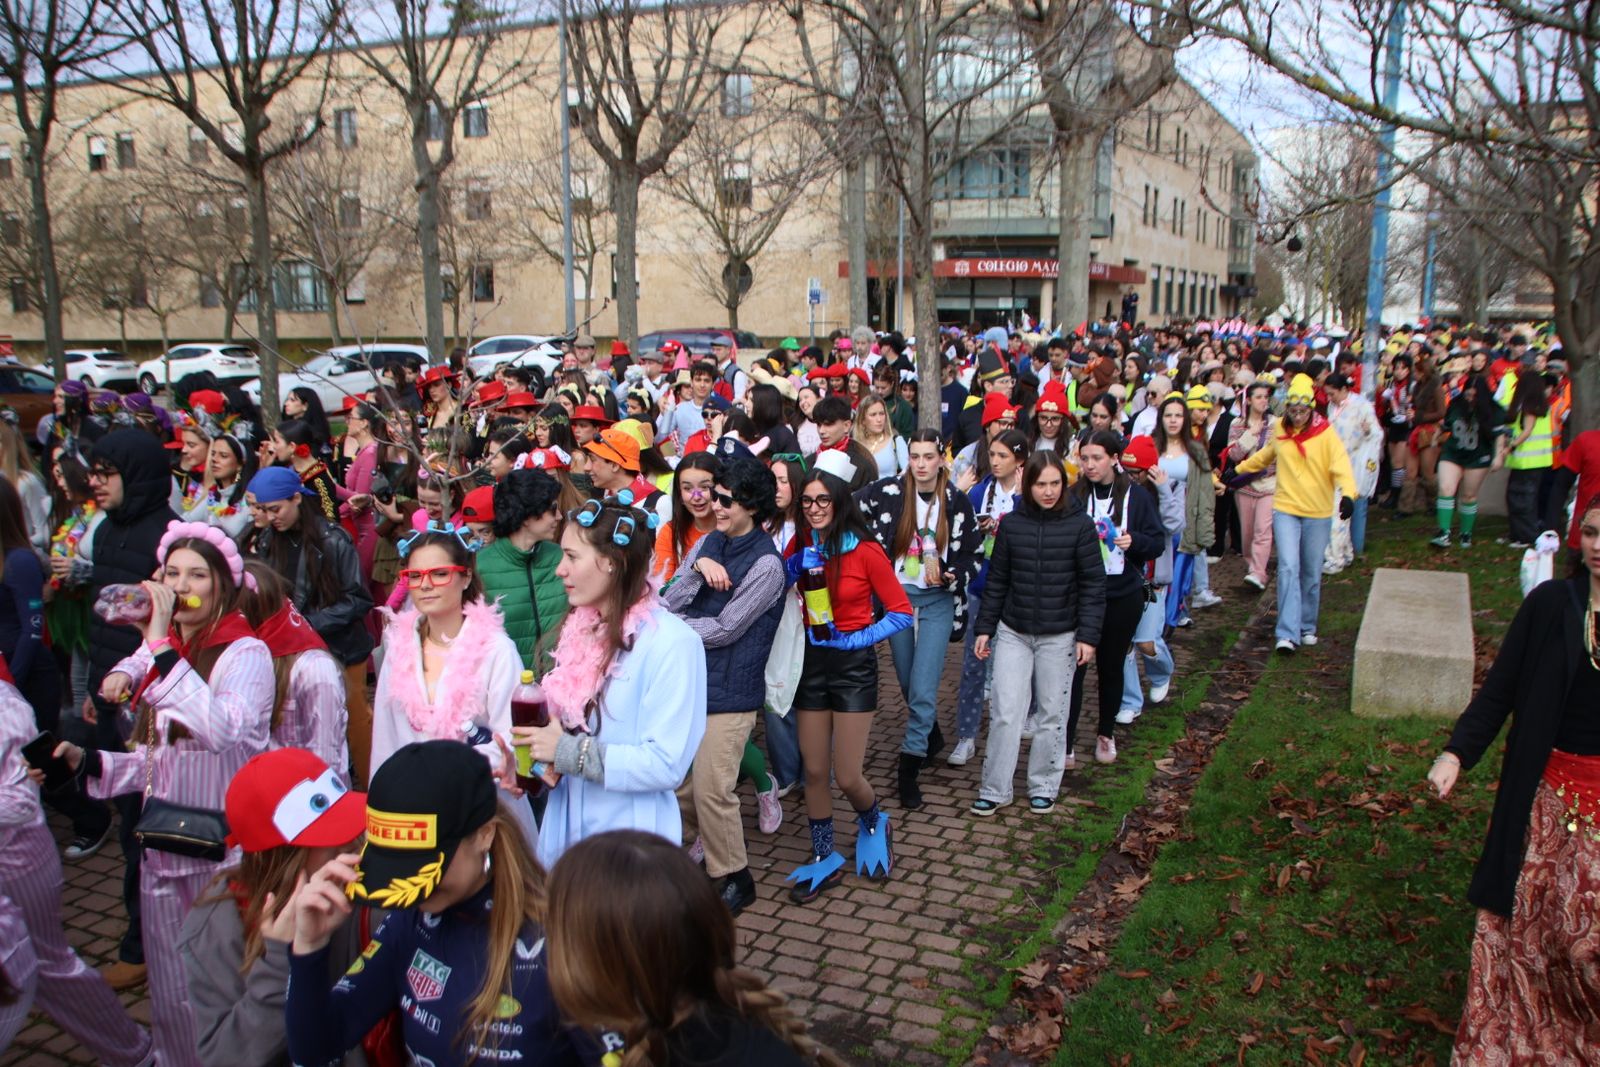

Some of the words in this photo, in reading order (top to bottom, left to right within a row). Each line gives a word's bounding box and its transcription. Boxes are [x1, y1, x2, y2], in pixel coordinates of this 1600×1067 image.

[977, 260, 1028, 273] COLEGIO
[418, 953, 447, 982] TAG
[409, 968, 442, 998] HEUER
[401, 994, 428, 1026] Mobil
[468, 1044, 523, 1060] HONDA
